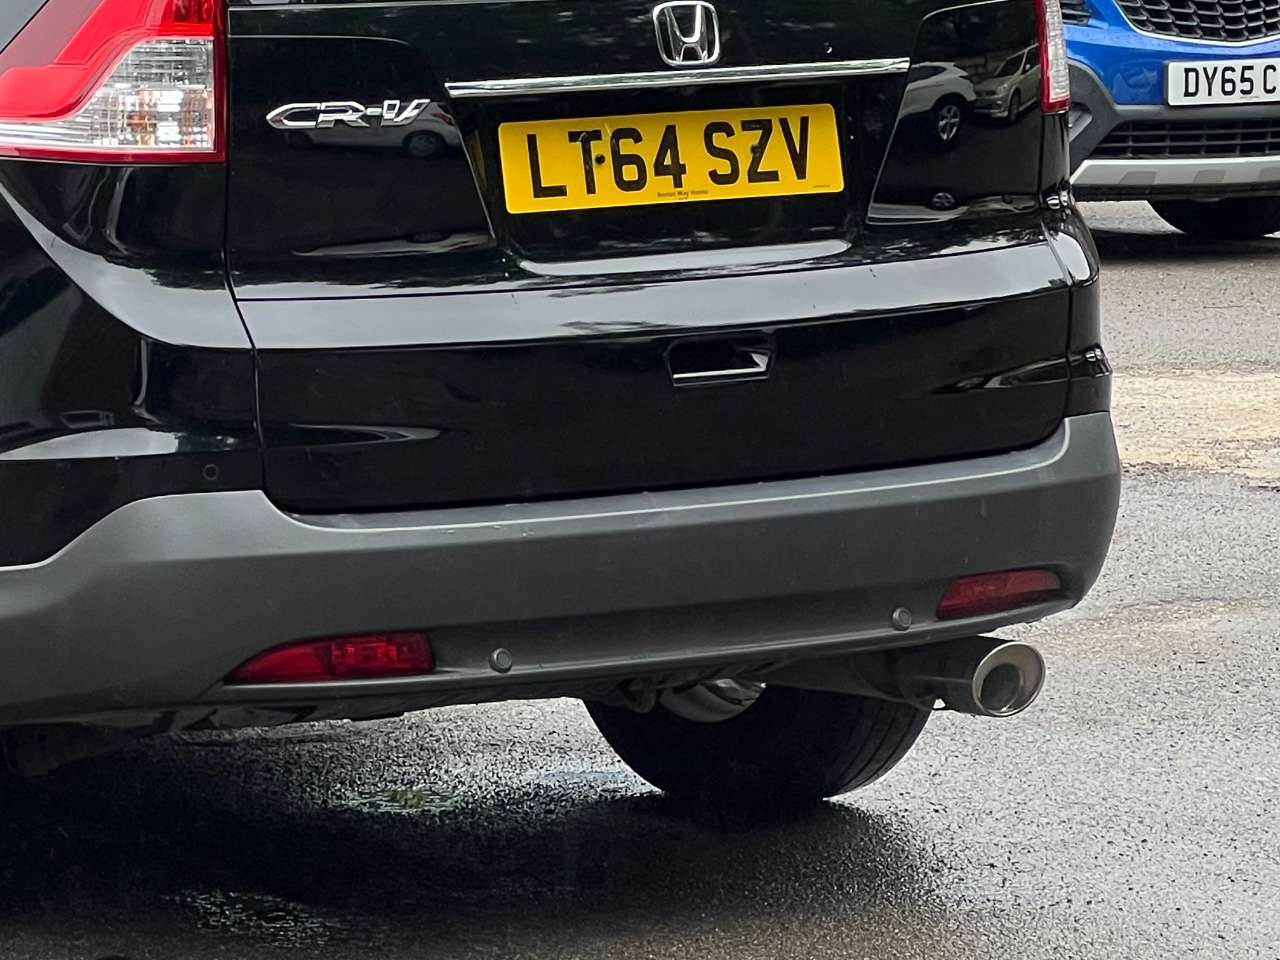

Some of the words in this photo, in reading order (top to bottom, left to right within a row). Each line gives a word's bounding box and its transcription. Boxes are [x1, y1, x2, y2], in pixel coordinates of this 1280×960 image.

[1183, 65, 1254, 97] DY65
[1263, 64, 1277, 94] C
[266, 99, 431, 129] CR-V
[526, 124, 687, 198] LT64
[703, 116, 810, 186] SZV
